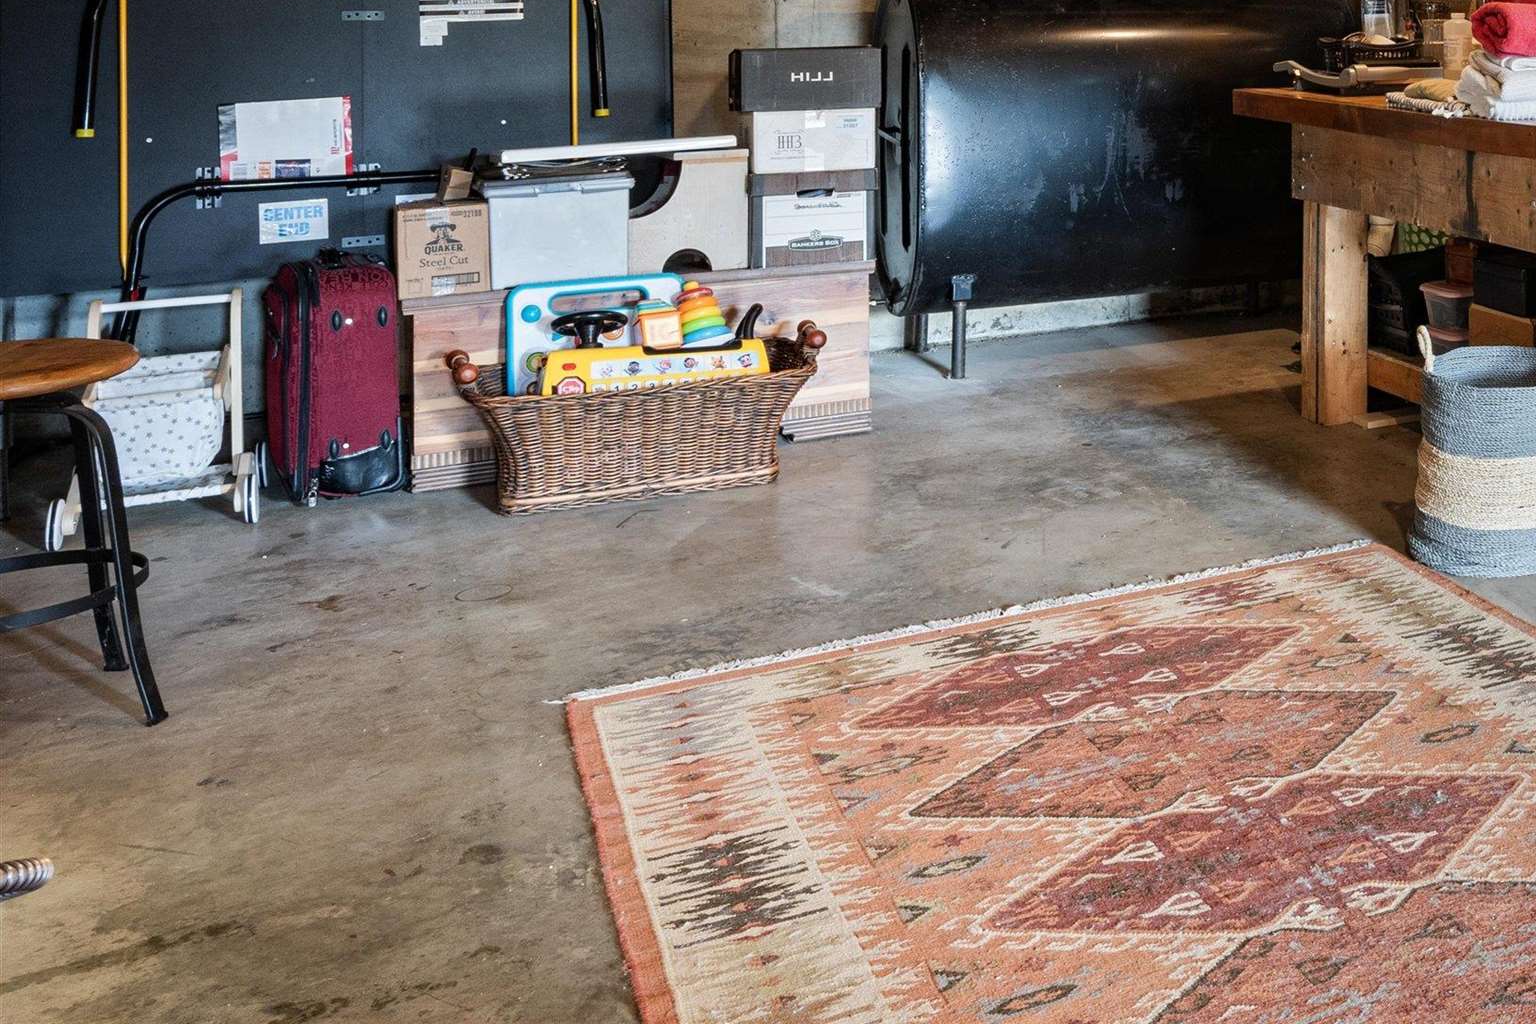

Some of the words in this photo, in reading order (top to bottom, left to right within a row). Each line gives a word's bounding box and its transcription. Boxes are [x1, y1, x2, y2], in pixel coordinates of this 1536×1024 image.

[424, 243, 464, 255] QUAKER
[419, 257, 447, 268] Steel
[449, 255, 469, 265] Cut
